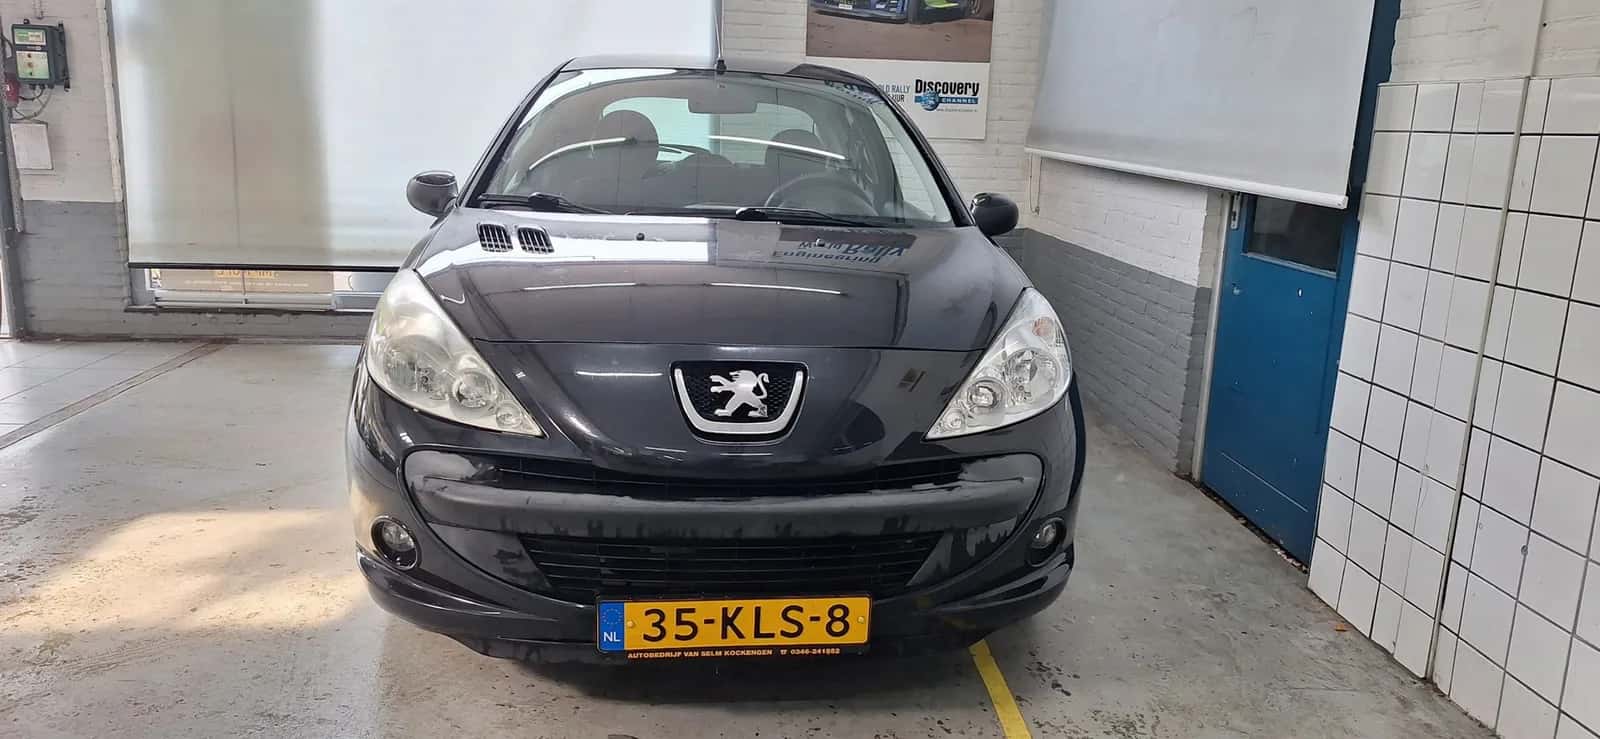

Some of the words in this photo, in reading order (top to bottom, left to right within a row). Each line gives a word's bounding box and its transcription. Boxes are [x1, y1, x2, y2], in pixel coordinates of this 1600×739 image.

[892, 84, 910, 93] RALLY
[915, 79, 980, 97] Discovery
[643, 604, 850, 642] 35-KLS-8
[603, 632, 621, 642] NL
[627, 651, 682, 659] AUTOBEDRIJF
